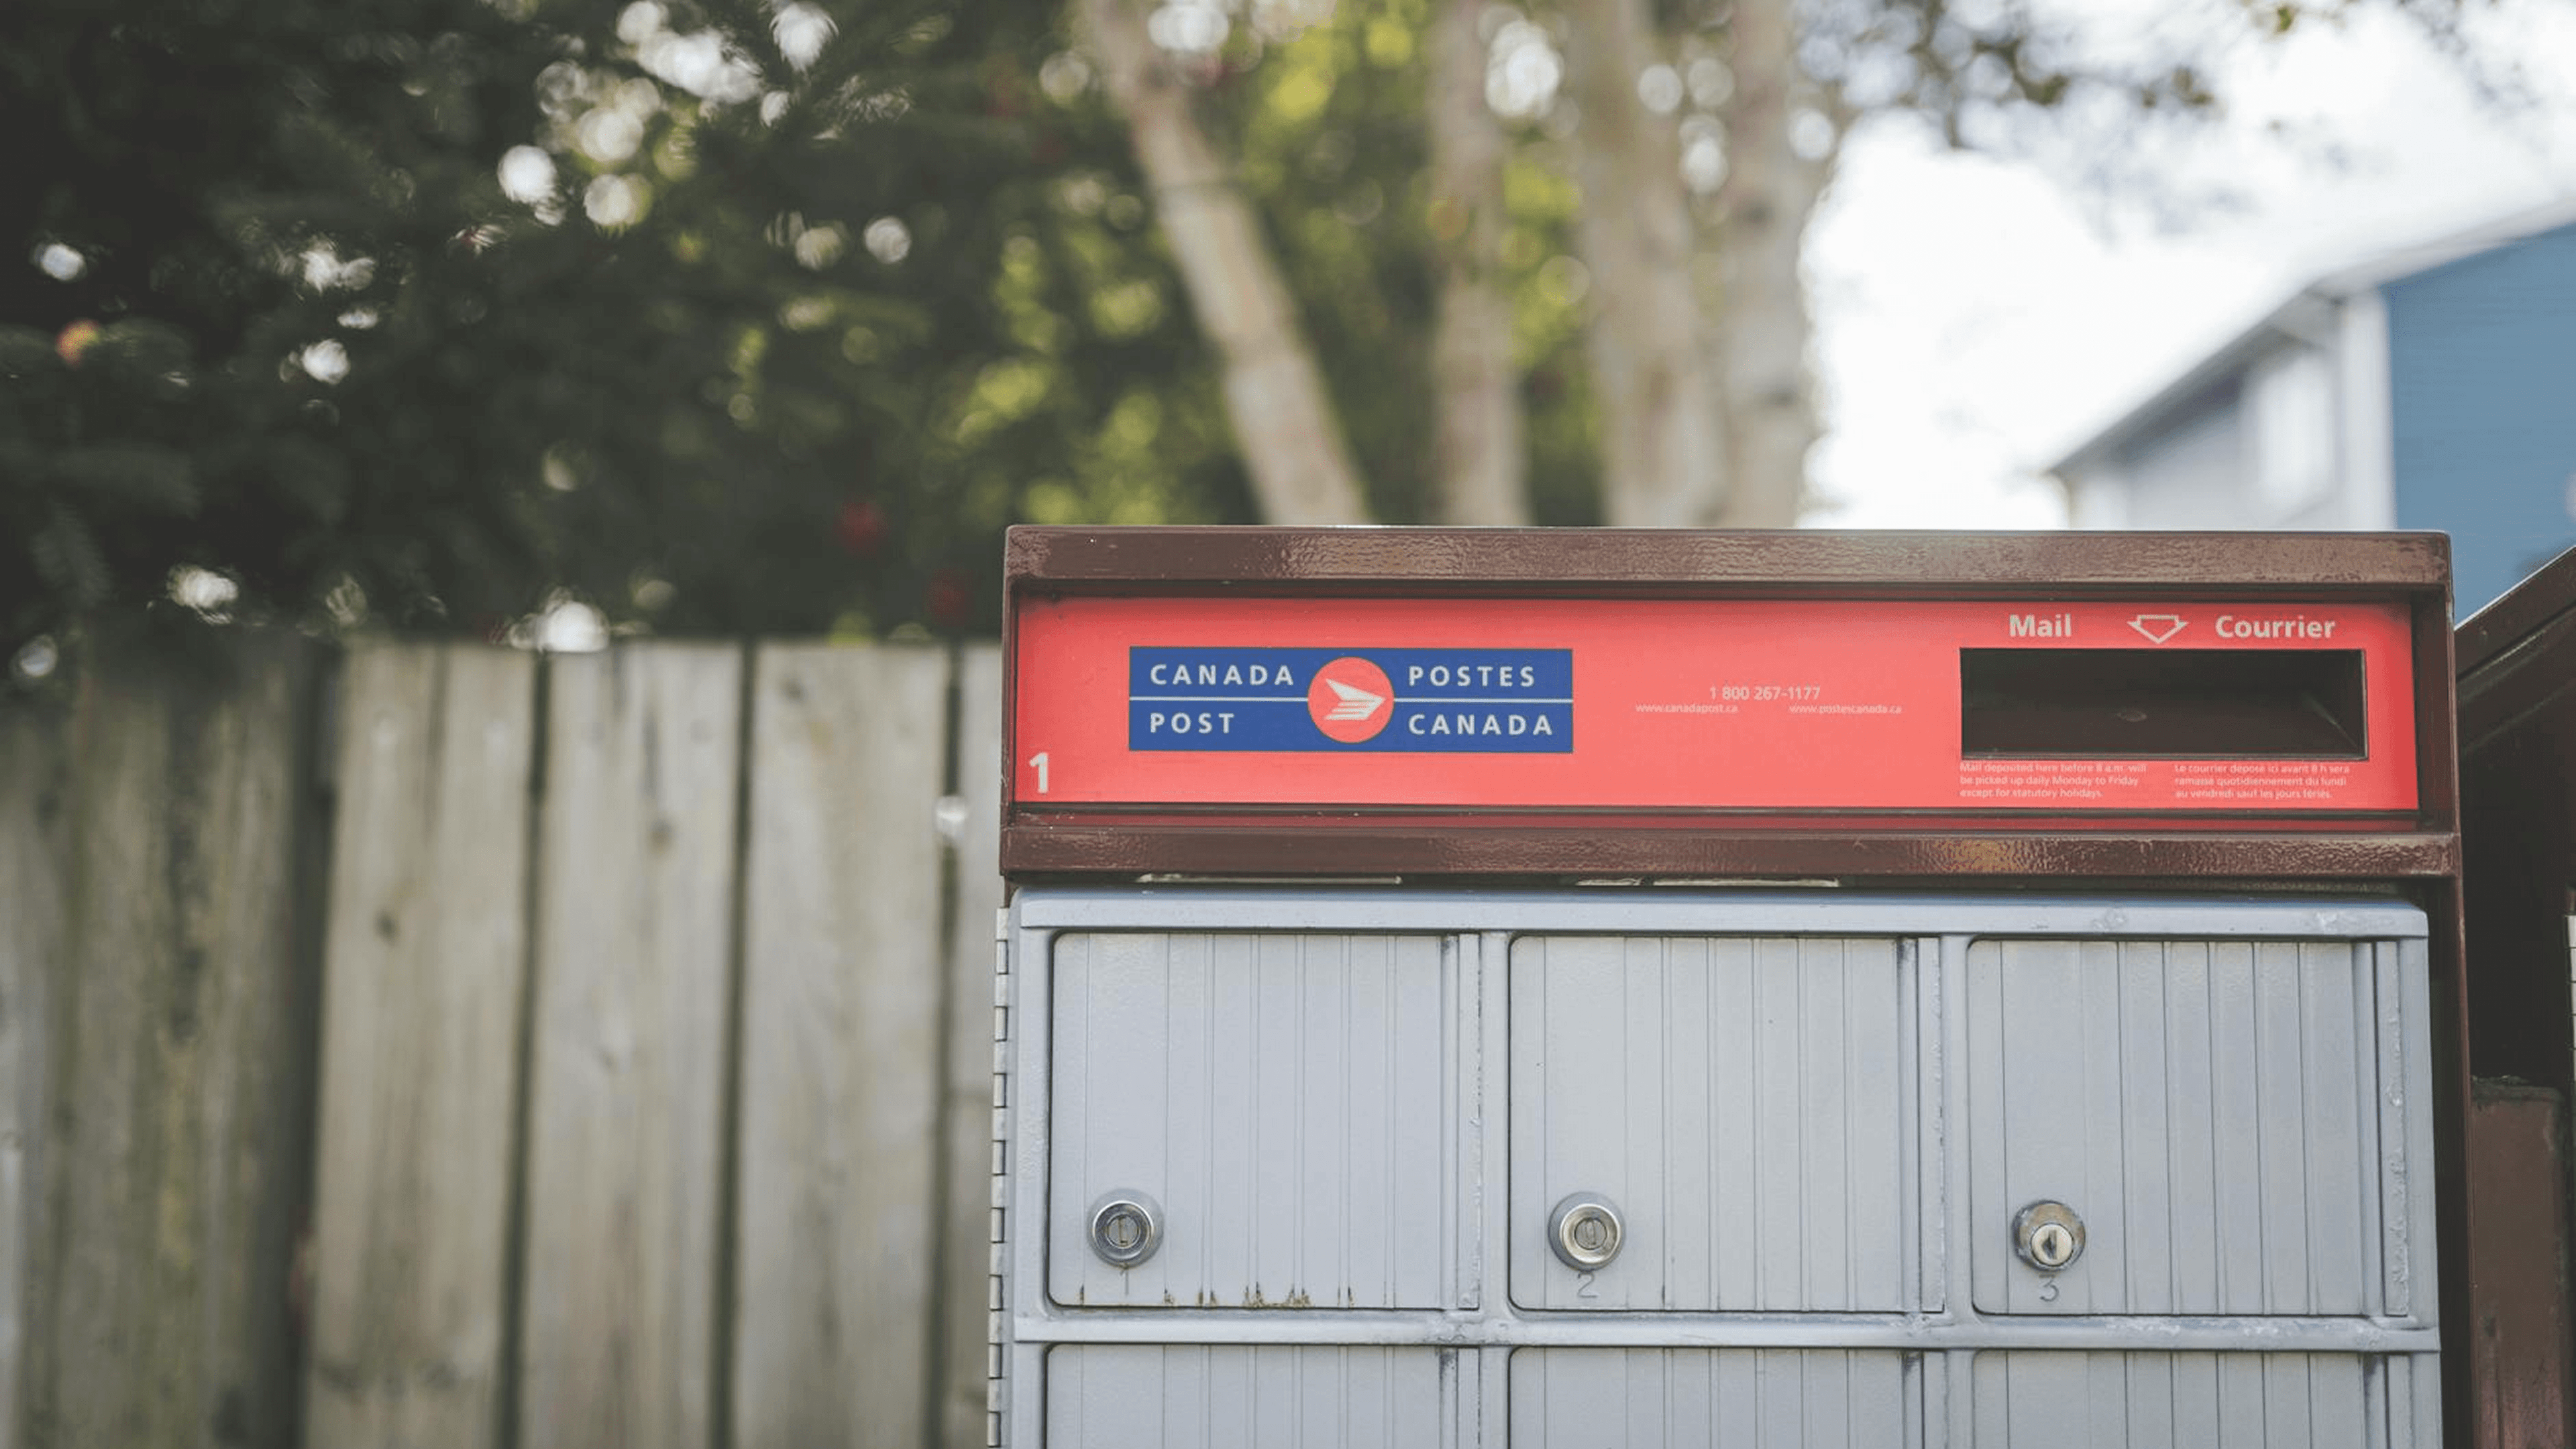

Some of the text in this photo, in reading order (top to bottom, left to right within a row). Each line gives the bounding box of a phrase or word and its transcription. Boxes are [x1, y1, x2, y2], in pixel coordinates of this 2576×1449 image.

[2008, 612, 2072, 638] Mail
[2214, 614, 2336, 639] Courrier
[1149, 663, 1294, 686] CANADA
[1408, 665, 1537, 688] POSTES
[1709, 686, 1821, 700] 1 800 267-1177
[1635, 702, 1739, 714] www.canadapost.ca
[1788, 704, 1903, 714] www.postescanada.ca
[1149, 712, 1236, 735] POST
[1408, 714, 1554, 737] CANADA
[1029, 752, 1049, 794] 1
[1960, 762, 1982, 772] Mail
[1984, 762, 2033, 773] deposited
[2035, 763, 2058, 772] here
[2060, 763, 2094, 772] before
[2127, 763, 2147, 772] will
[2174, 763, 2187, 773] Le
[2187, 764, 2228, 773] courrier
[2280, 765, 2310, 773] avant
[2319, 763, 2328, 773] h
[2328, 765, 2351, 773] sera
[1960, 775, 2139, 788] be picked up daily Monday to Friday
[2304, 776, 2320, 786] du
[2320, 775, 2348, 786] lundi
[1960, 788, 1992, 799] except
[1995, 787, 2010, 797] for
[2012, 788, 2057, 800] statutory
[2175, 790, 2189, 798] au
[2190, 788, 2235, 798] vendredi
[2235, 788, 2258, 798] sauf
[2259, 788, 2274, 798] les
[2275, 789, 2302, 800] jours
[1576, 1271, 1599, 1299] 2
[2038, 1274, 2060, 1303] 3
